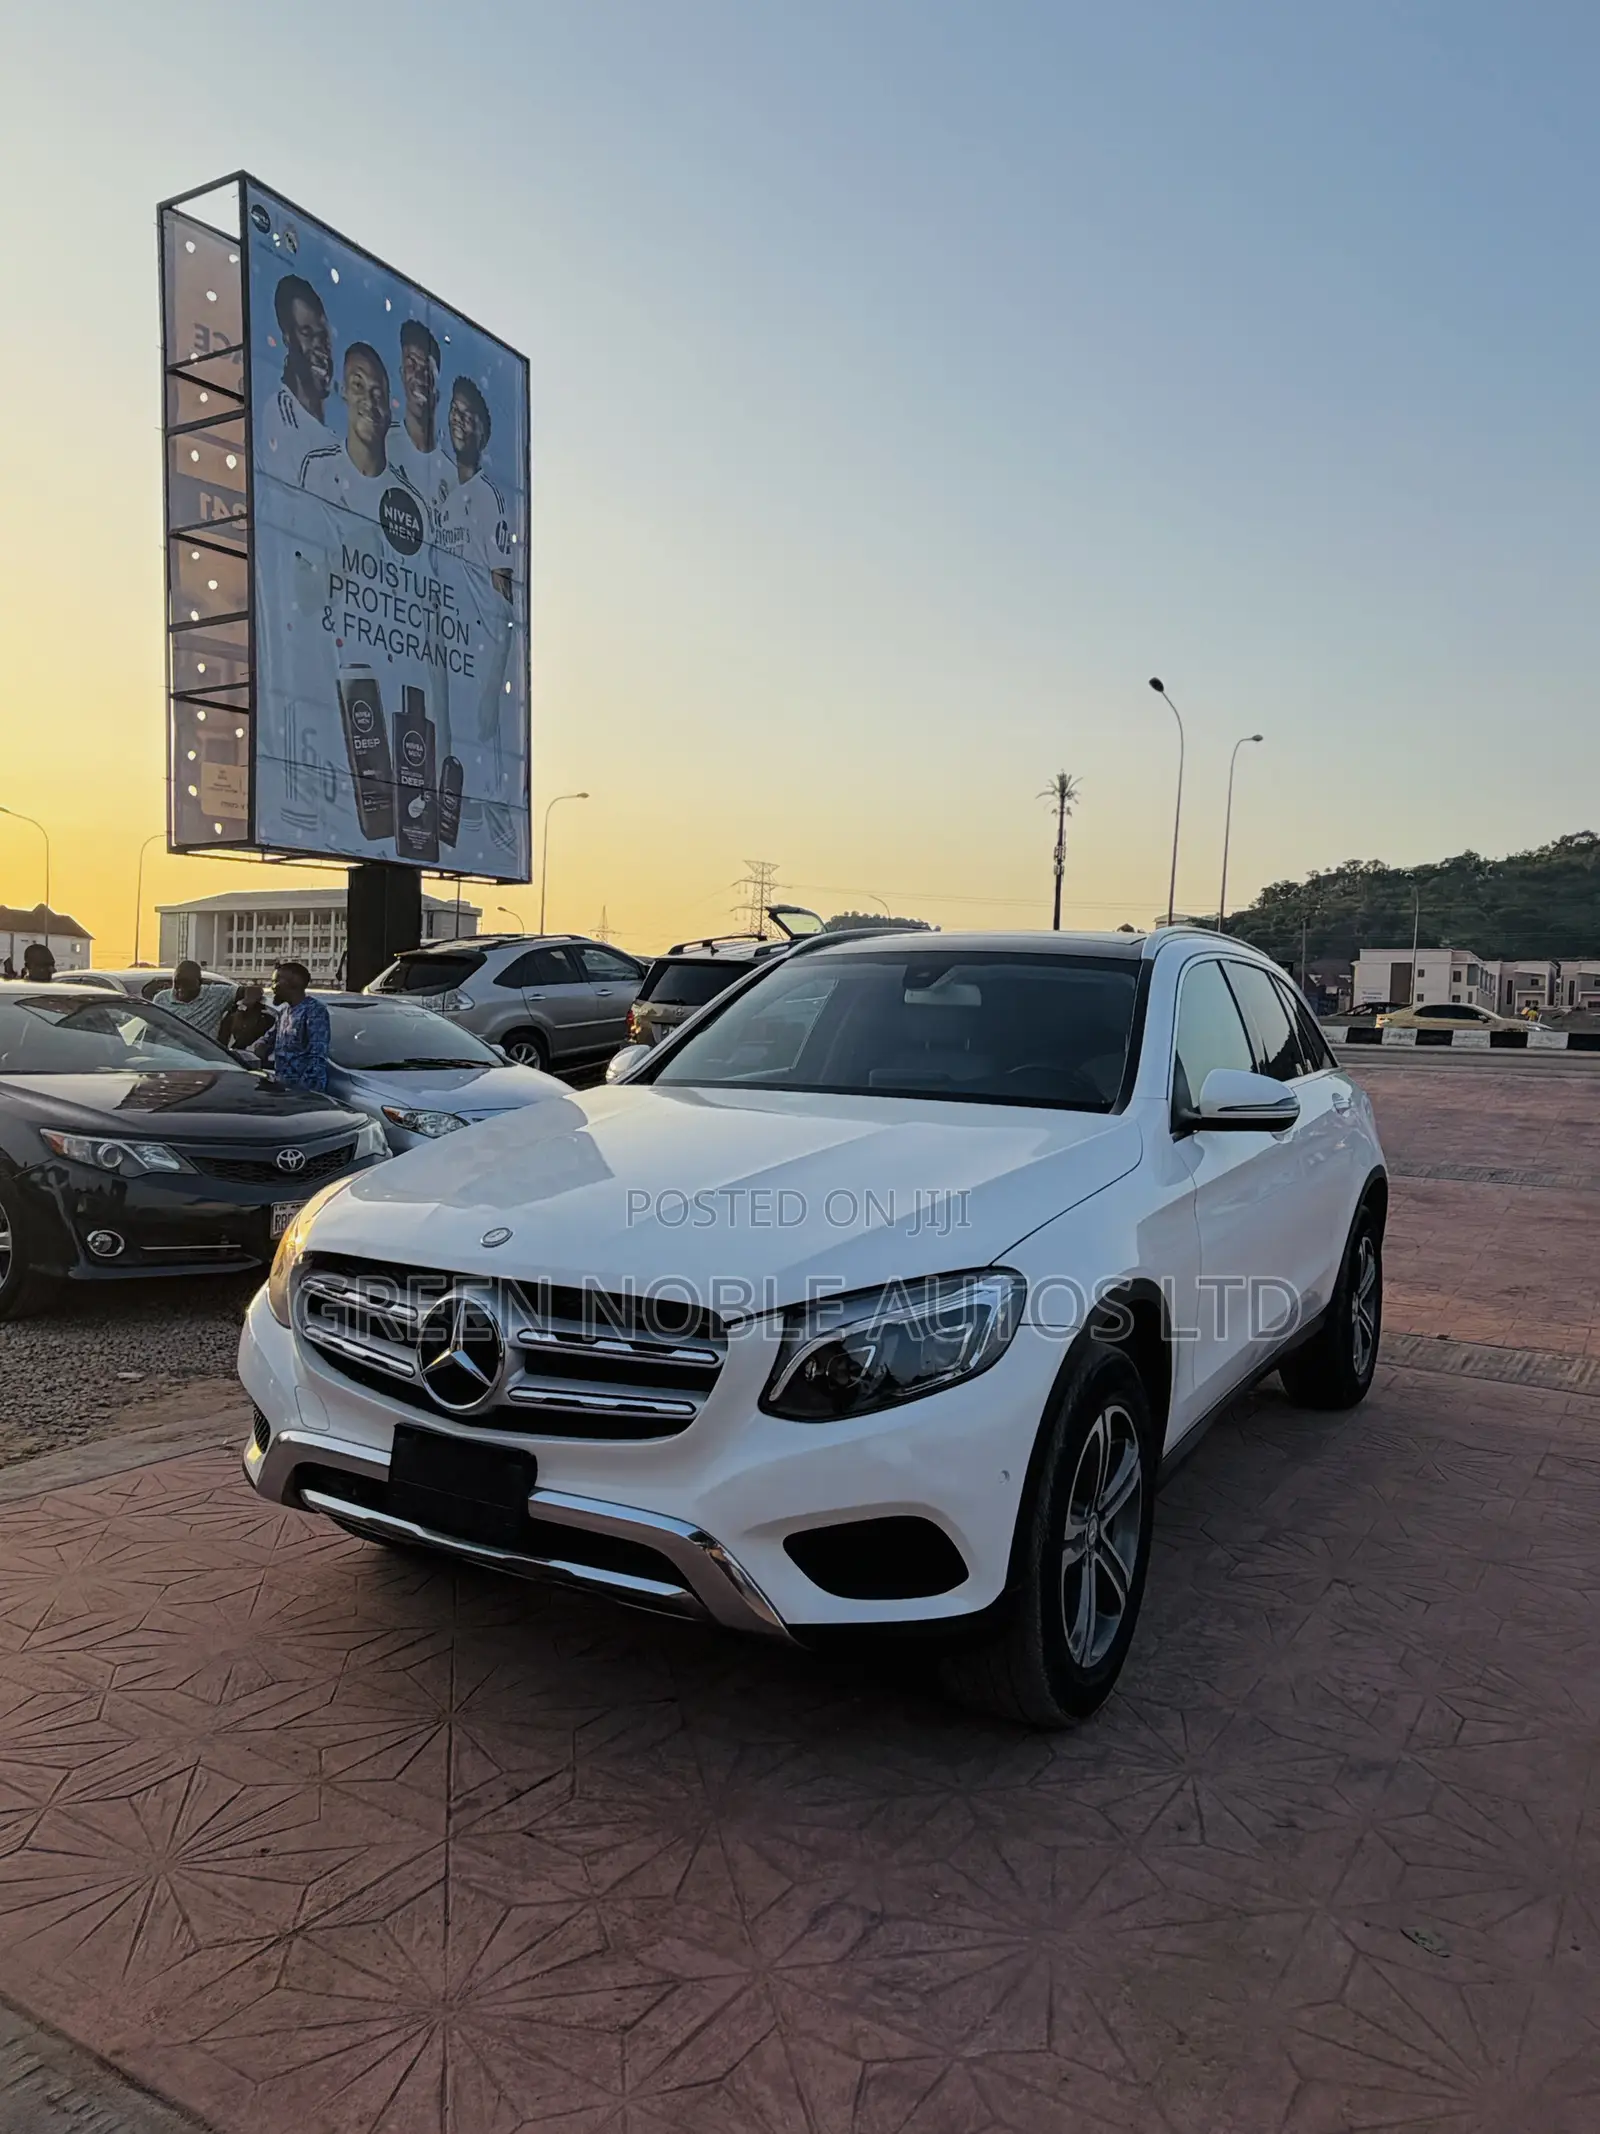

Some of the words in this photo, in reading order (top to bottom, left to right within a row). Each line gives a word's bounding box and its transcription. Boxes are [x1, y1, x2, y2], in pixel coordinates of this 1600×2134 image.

[384, 503, 420, 531] NIVEA
[388, 522, 415, 543] MEN
[342, 544, 460, 616] MOISTURE,
[329, 573, 469, 646] PROTECTION
[321, 605, 336, 633] &
[343, 612, 475, 678] FRAGRANCE
[354, 738, 381, 750] DEEP
[401, 776, 425, 787] DEEP
